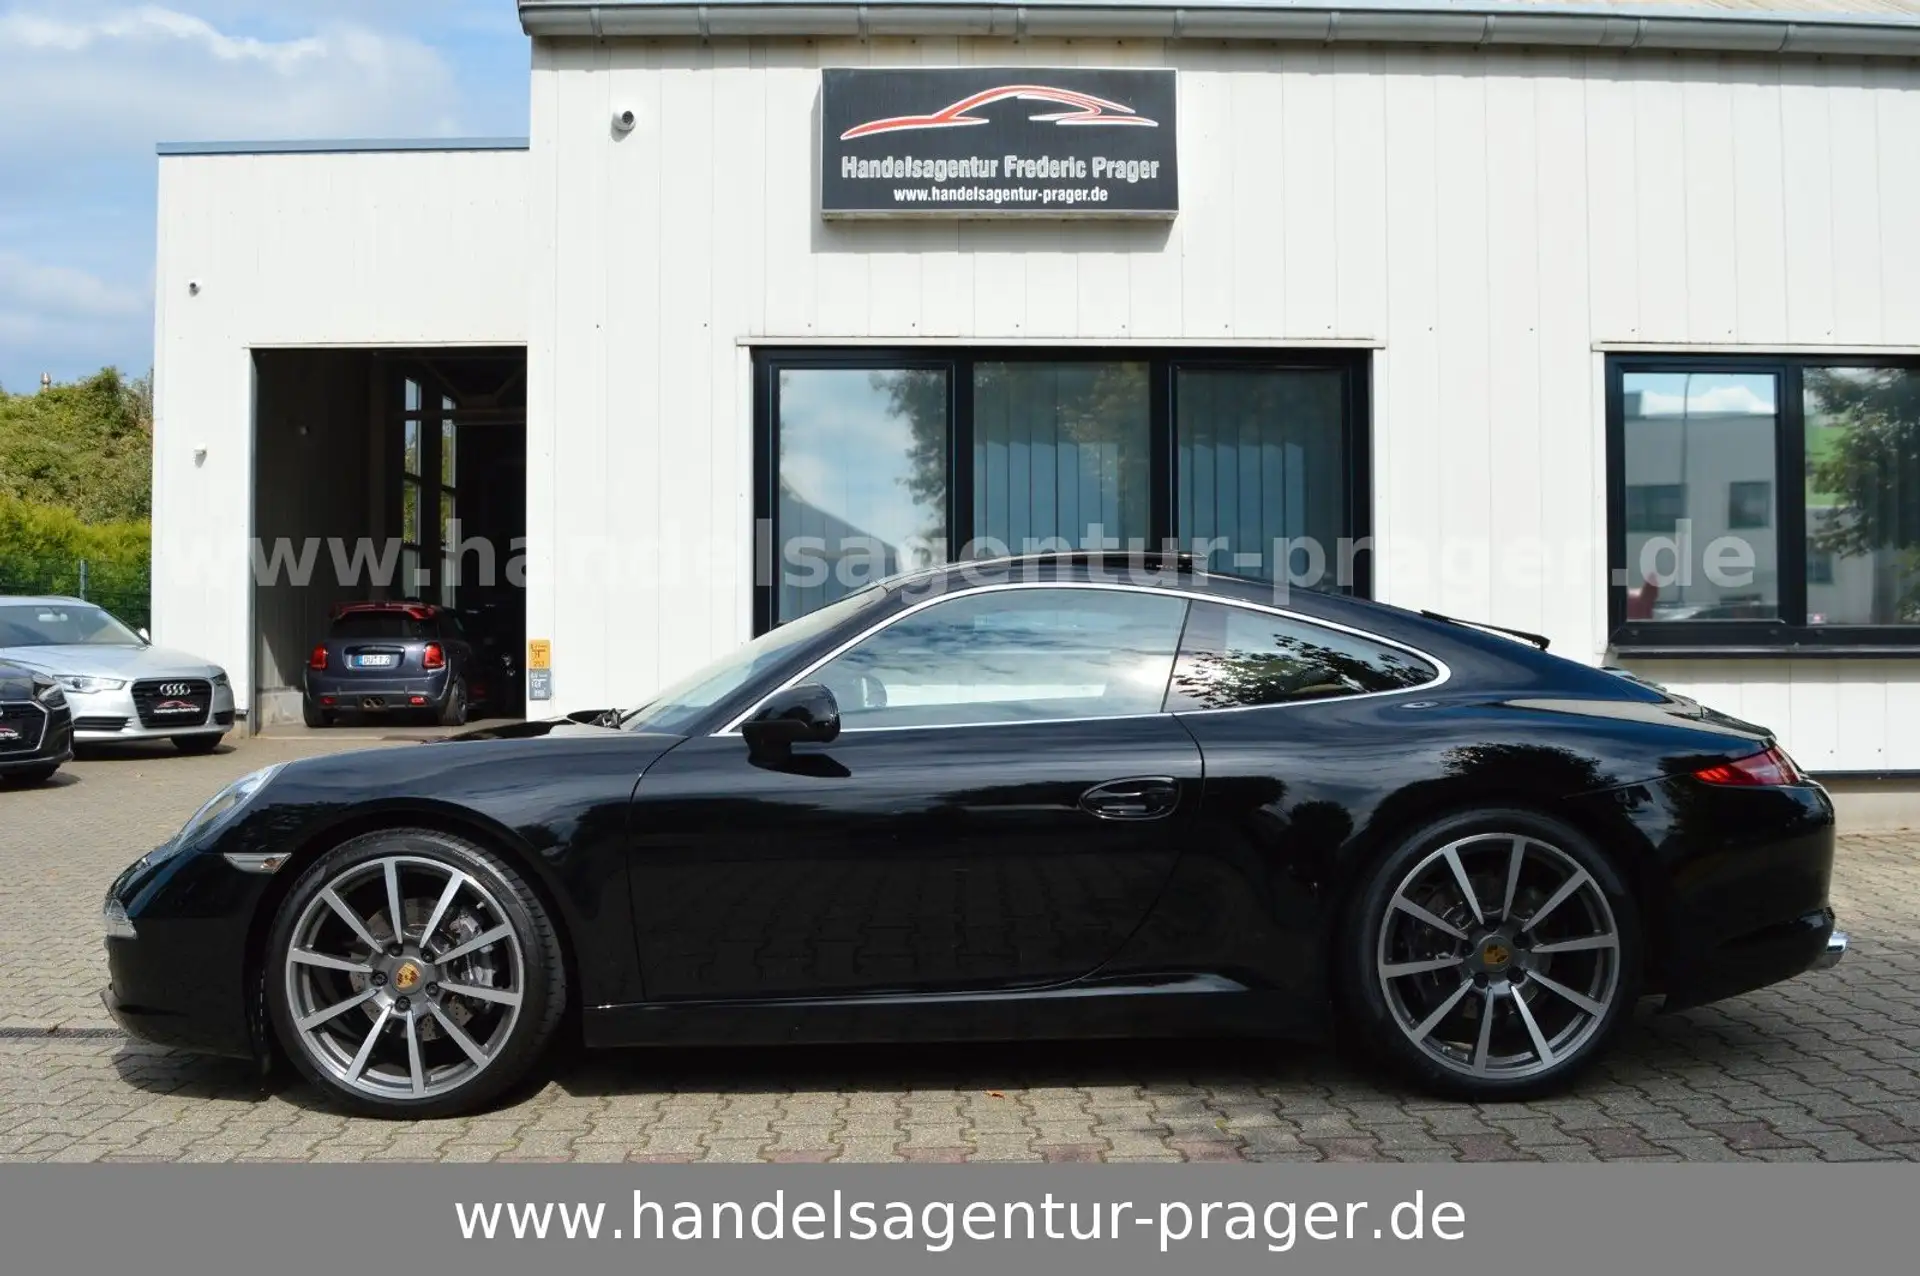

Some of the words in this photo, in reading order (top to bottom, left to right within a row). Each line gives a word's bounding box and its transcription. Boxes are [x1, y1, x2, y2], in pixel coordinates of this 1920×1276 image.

[841, 155, 999, 183] Handelsagentur
[1004, 155, 1088, 180] Frederic
[1092, 156, 1160, 184] Prager
[893, 186, 1109, 205] www.handelsagentur-prager.de
